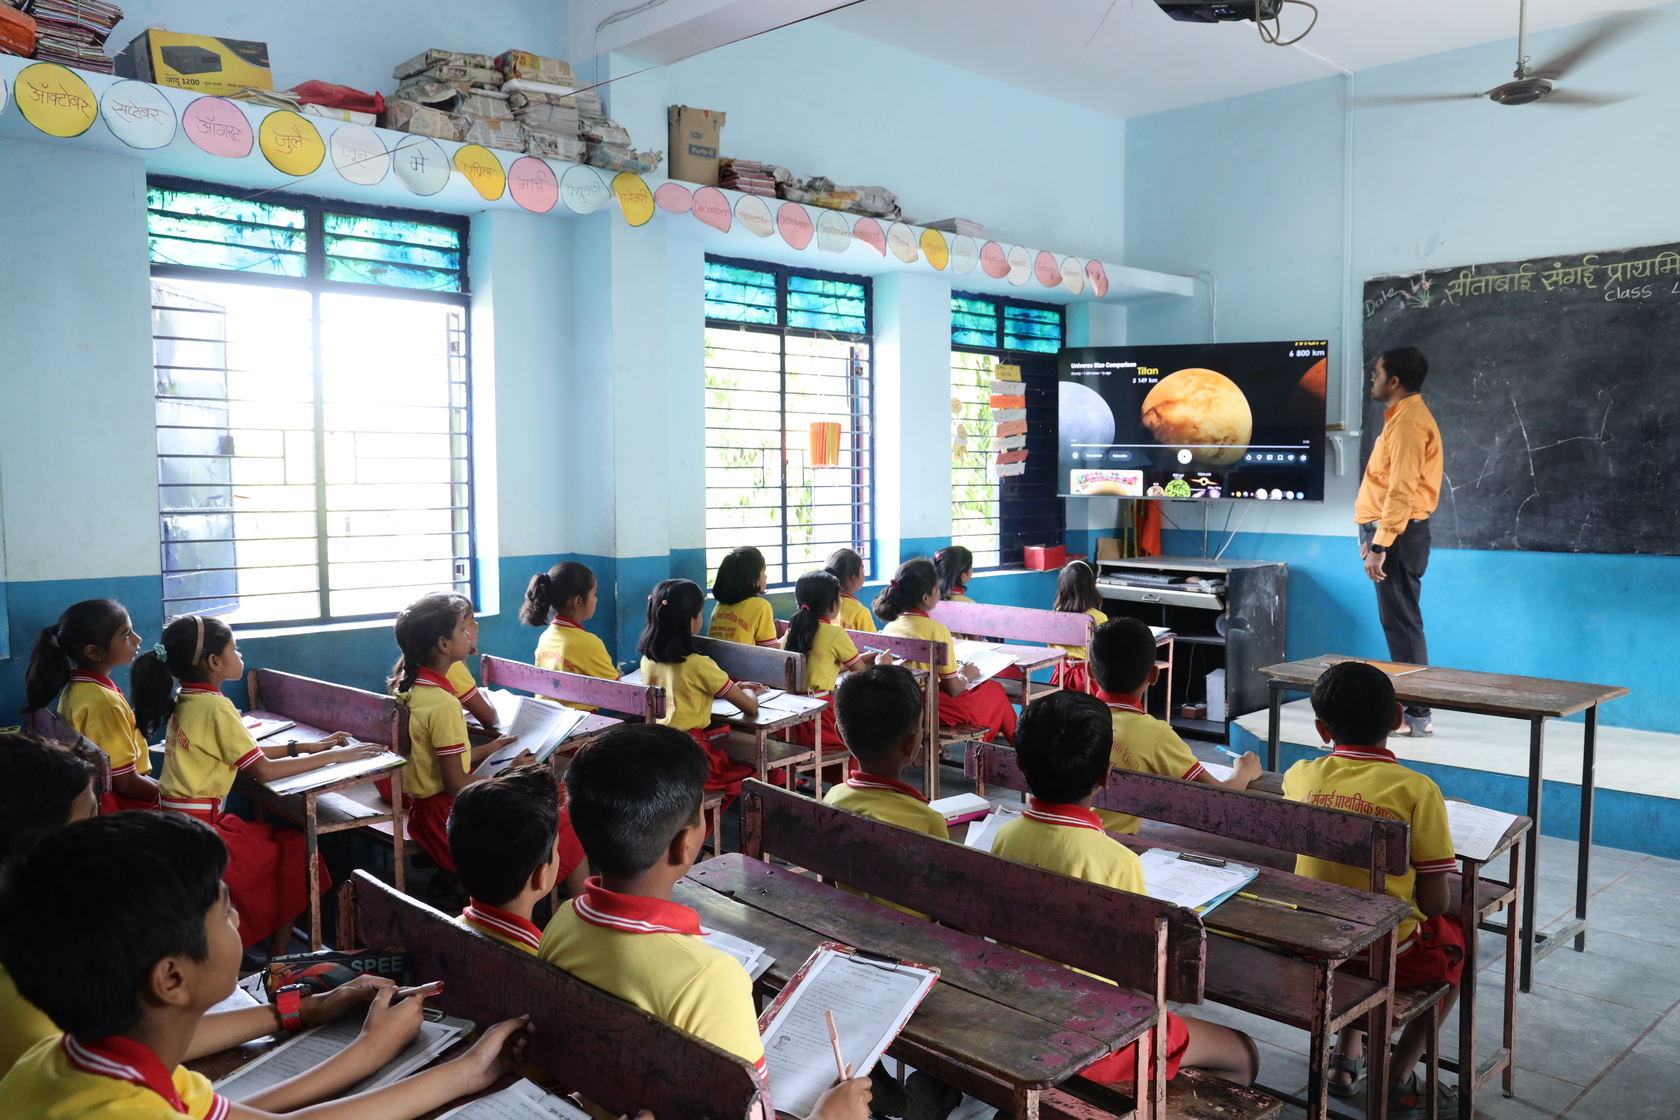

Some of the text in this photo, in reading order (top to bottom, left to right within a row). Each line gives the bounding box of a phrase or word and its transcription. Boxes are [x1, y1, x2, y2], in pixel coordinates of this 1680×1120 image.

[181, 77, 200, 86] 1200
[196, 115, 243, 142] ऑगस्ट
[341, 143, 375, 169] जून
[409, 148, 429, 174] मे
[516, 170, 549, 192] मार्च
[694, 200, 730, 217] December
[739, 211, 773, 227] November
[819, 222, 852, 238] September
[892, 235, 910, 253] July
[955, 246, 972, 264] May
[1364, 287, 1400, 317] Date
[1296, 349, 1310, 357] 800
[1312, 349, 1325, 357] km
[1106, 361, 1137, 369] Comparison
[1137, 366, 1159, 375] Titan
[992, 382, 1018, 391] SUNDAY
[992, 397, 1018, 405] MONDAY
[993, 410, 1018, 420] TUESDAY
[994, 436, 1020, 447] THURSDAY
[1310, 789, 1337, 808] संगई
[1335, 793, 1374, 815] प्राथमिक
[351, 956, 404, 974] SPEE
